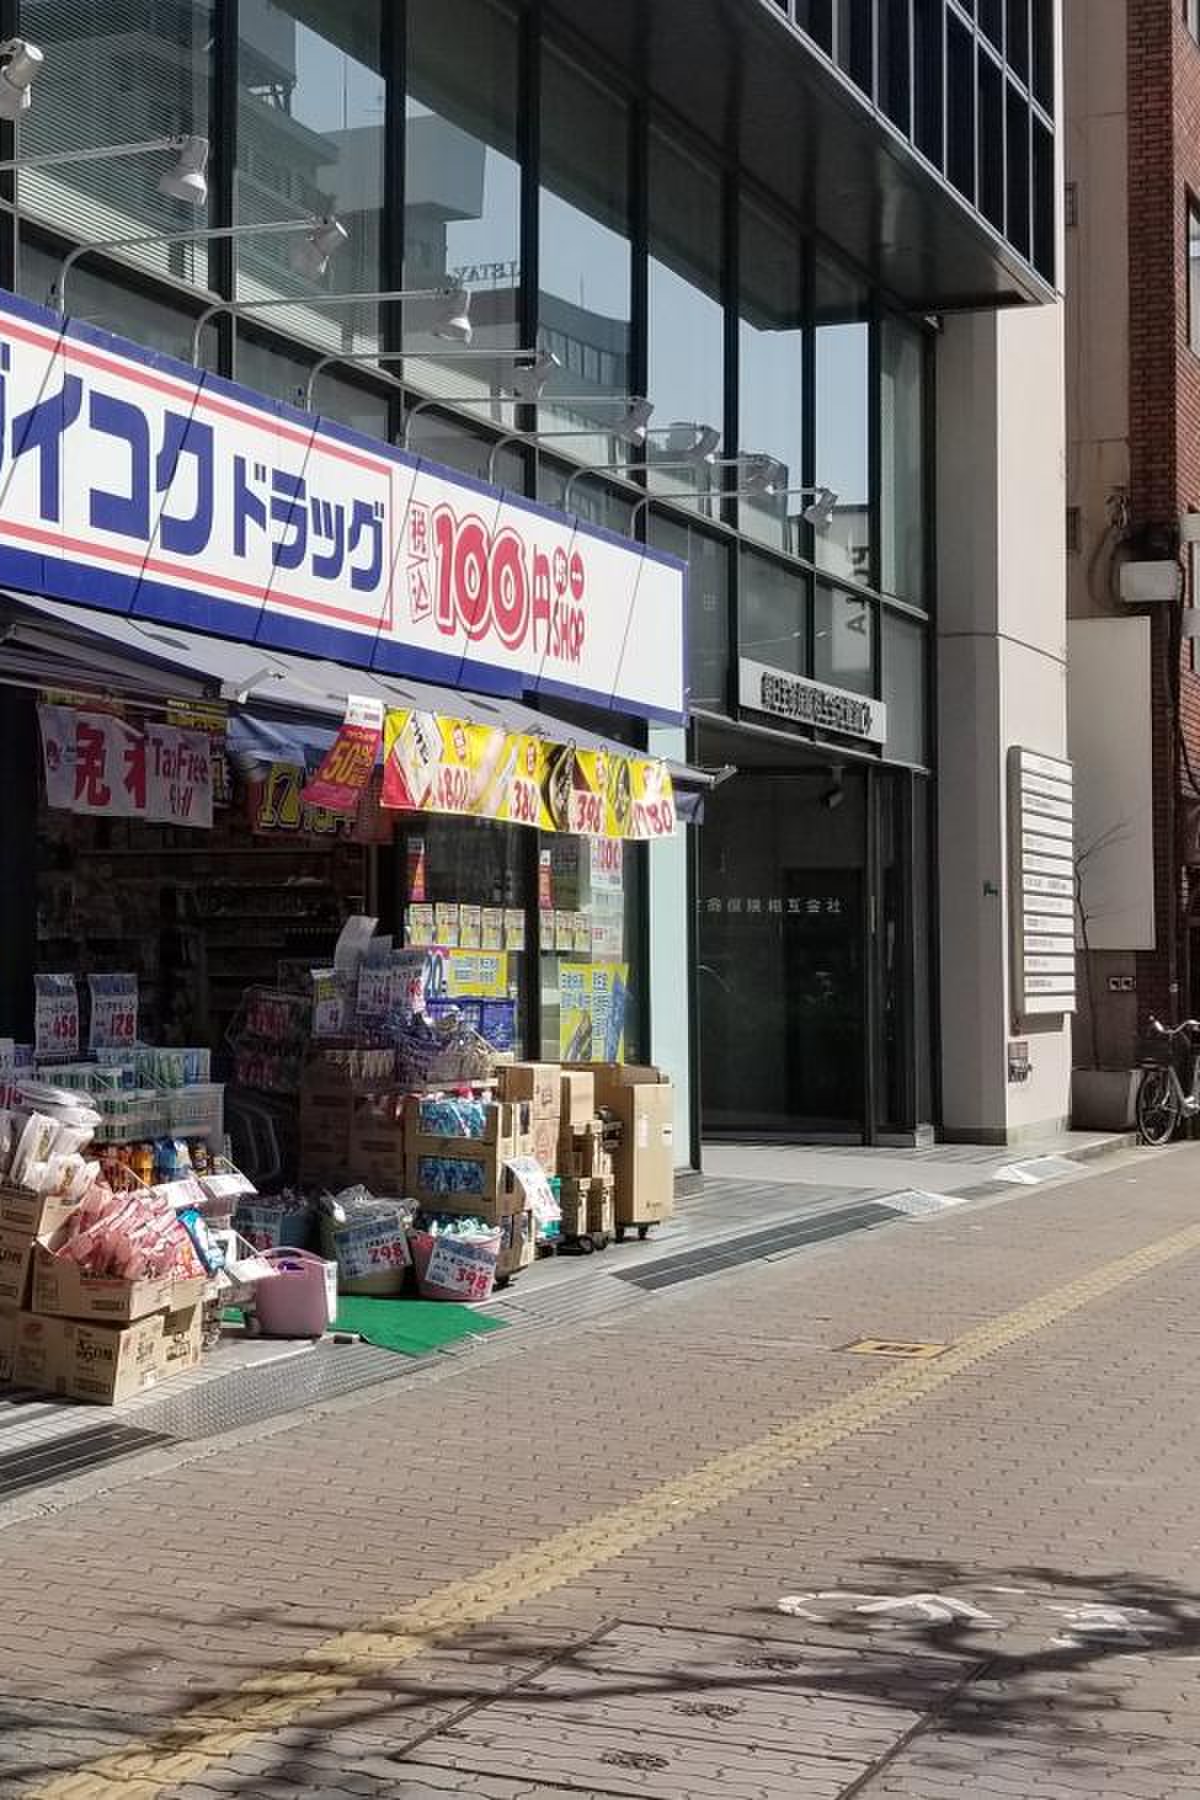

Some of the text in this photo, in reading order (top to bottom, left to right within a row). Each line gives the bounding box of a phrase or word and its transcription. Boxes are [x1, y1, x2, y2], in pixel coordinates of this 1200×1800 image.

[233, 454, 385, 593] ドラッグ
[552, 598, 585, 665] SHOP
[368, 1243, 403, 1264] 298
[455, 1267, 489, 1291] 398
